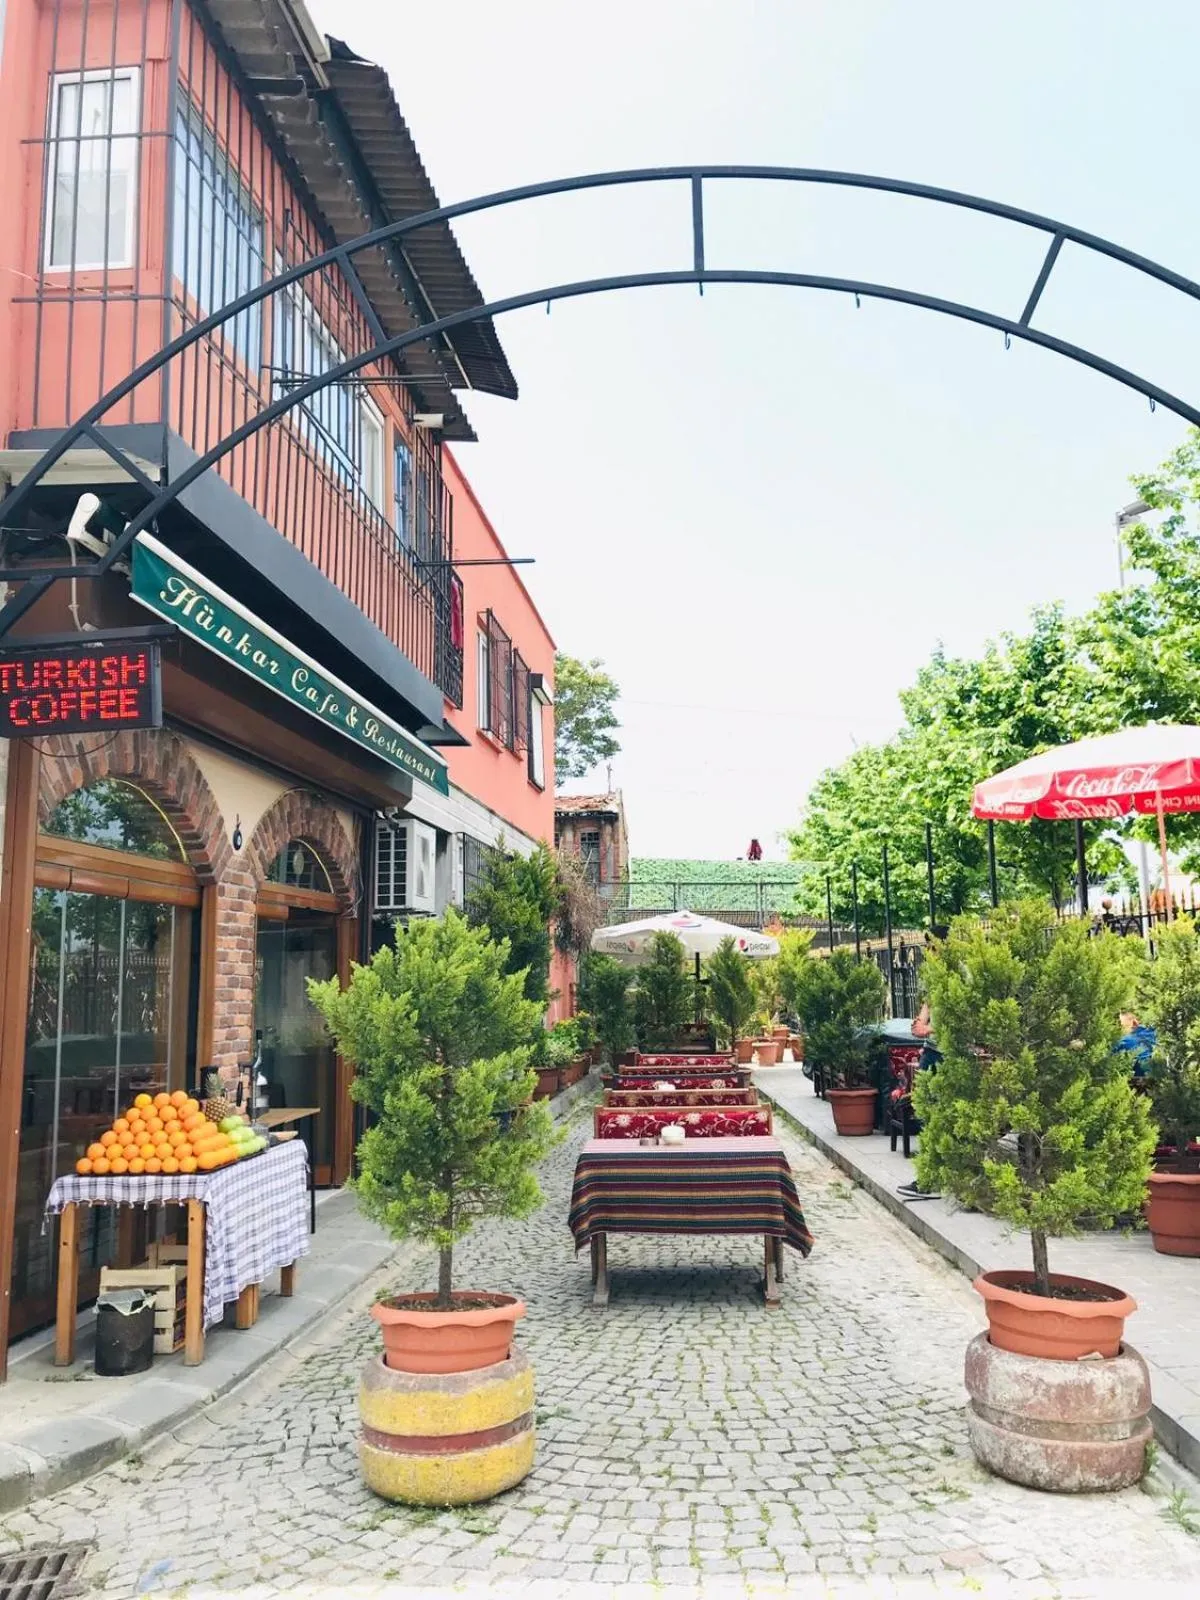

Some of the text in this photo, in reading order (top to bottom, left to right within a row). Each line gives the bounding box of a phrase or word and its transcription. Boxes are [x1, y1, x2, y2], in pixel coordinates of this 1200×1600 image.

[0, 654, 146, 693] TURKISH
[159, 576, 436, 782] Hünkar Cafe & Restaurant
[9, 688, 140, 727] COFFEE
